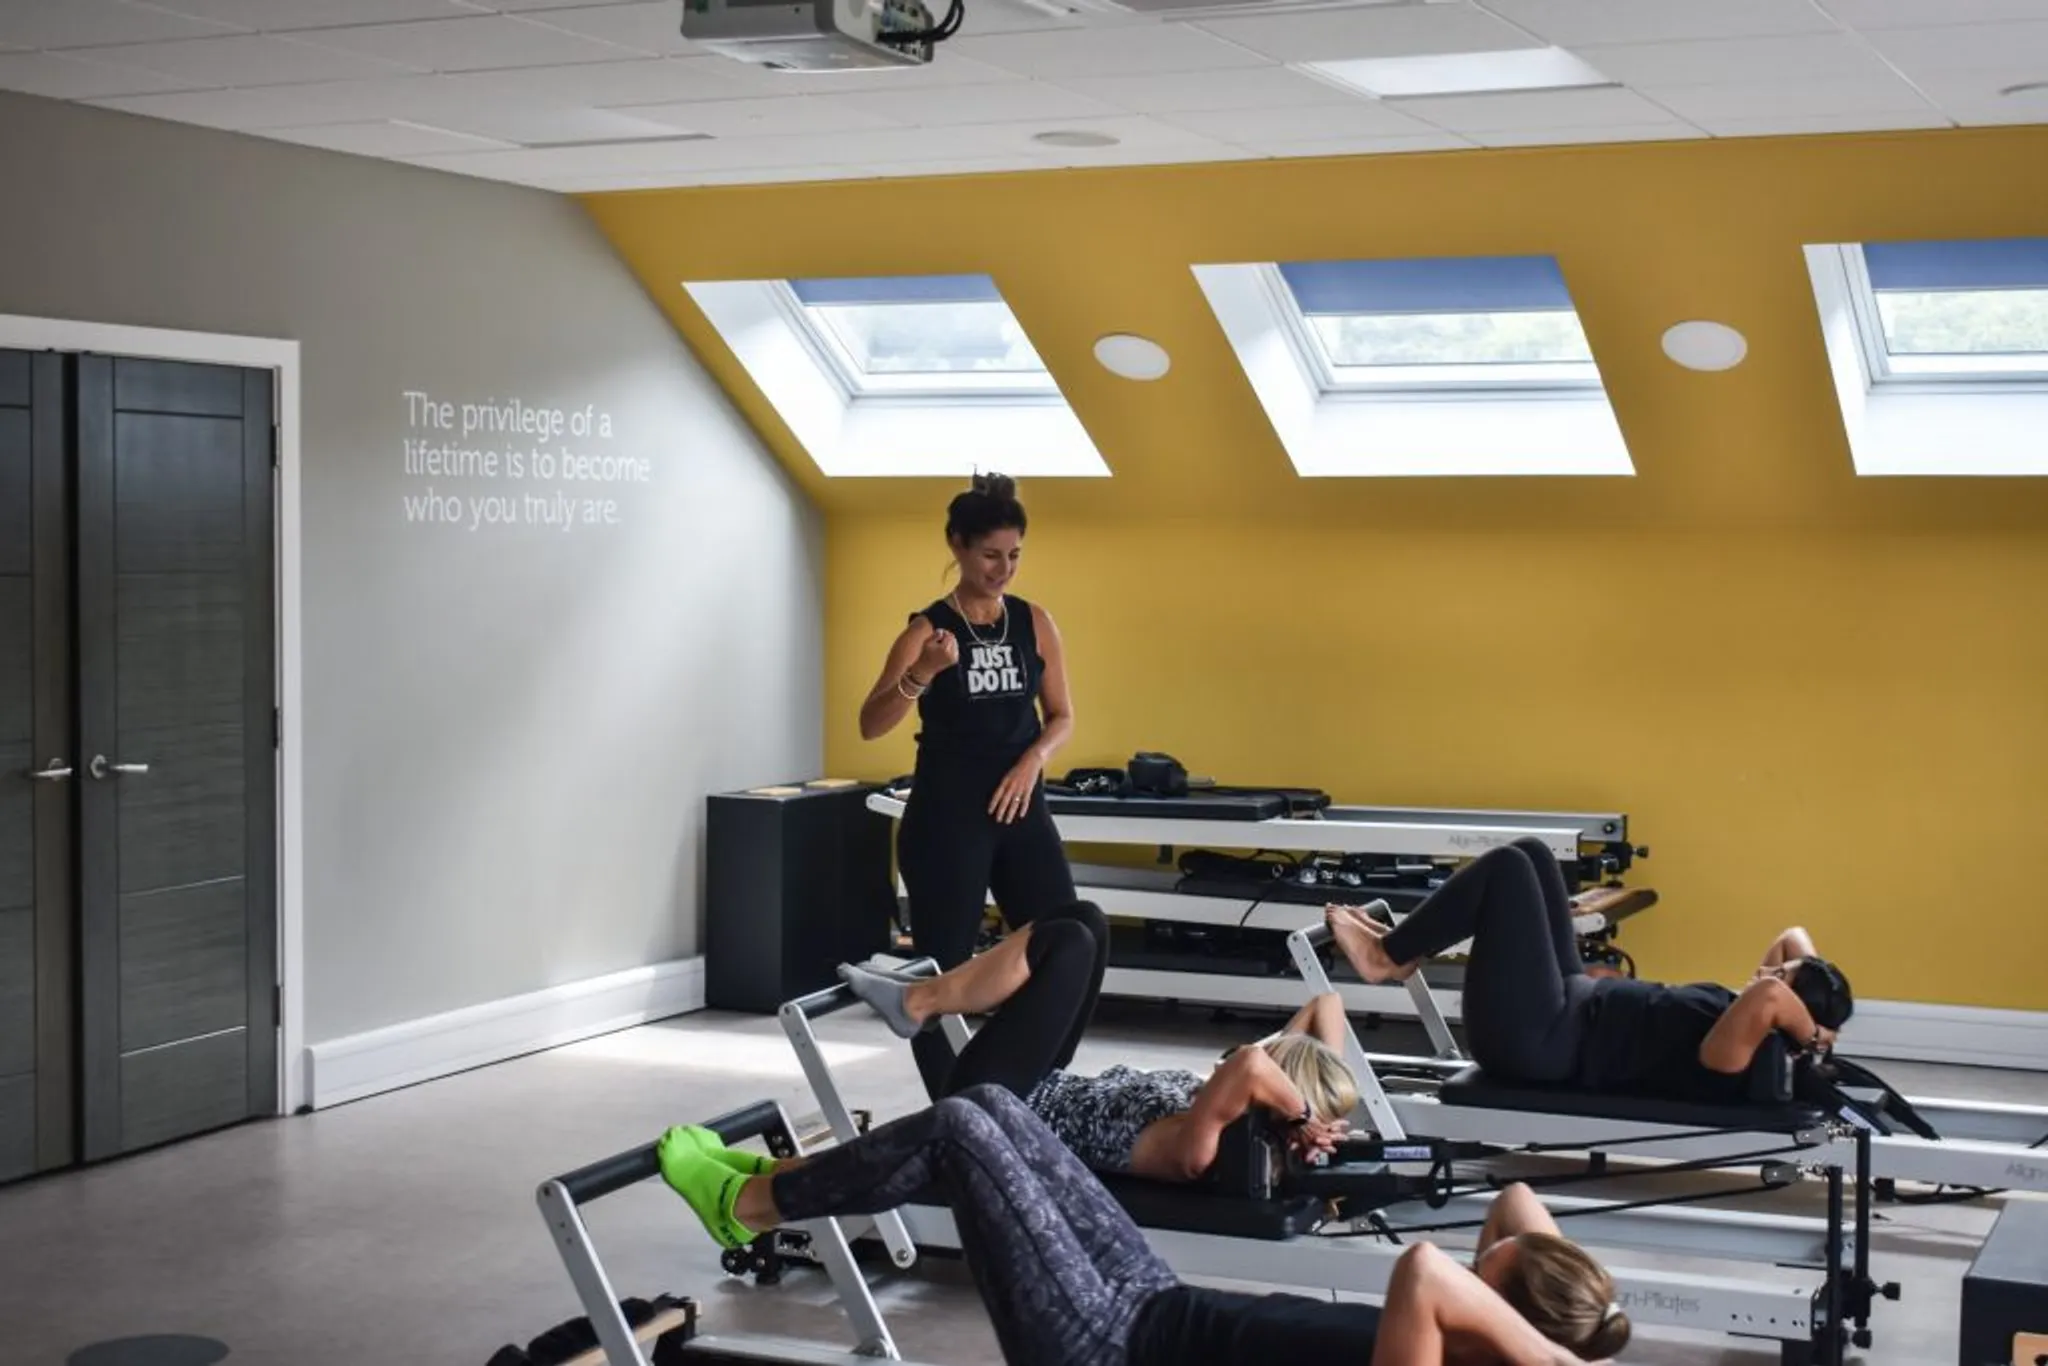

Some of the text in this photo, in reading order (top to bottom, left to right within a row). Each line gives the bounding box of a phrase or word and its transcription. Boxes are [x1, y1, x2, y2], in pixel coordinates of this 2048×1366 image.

[403, 391, 613, 443] The privilege of a
[403, 439, 651, 482] lifetime is to become
[403, 486, 462, 523] who
[469, 495, 516, 532] you
[524, 489, 576, 532] truly
[971, 644, 1013, 669] JUST
[967, 669, 999, 693] DO
